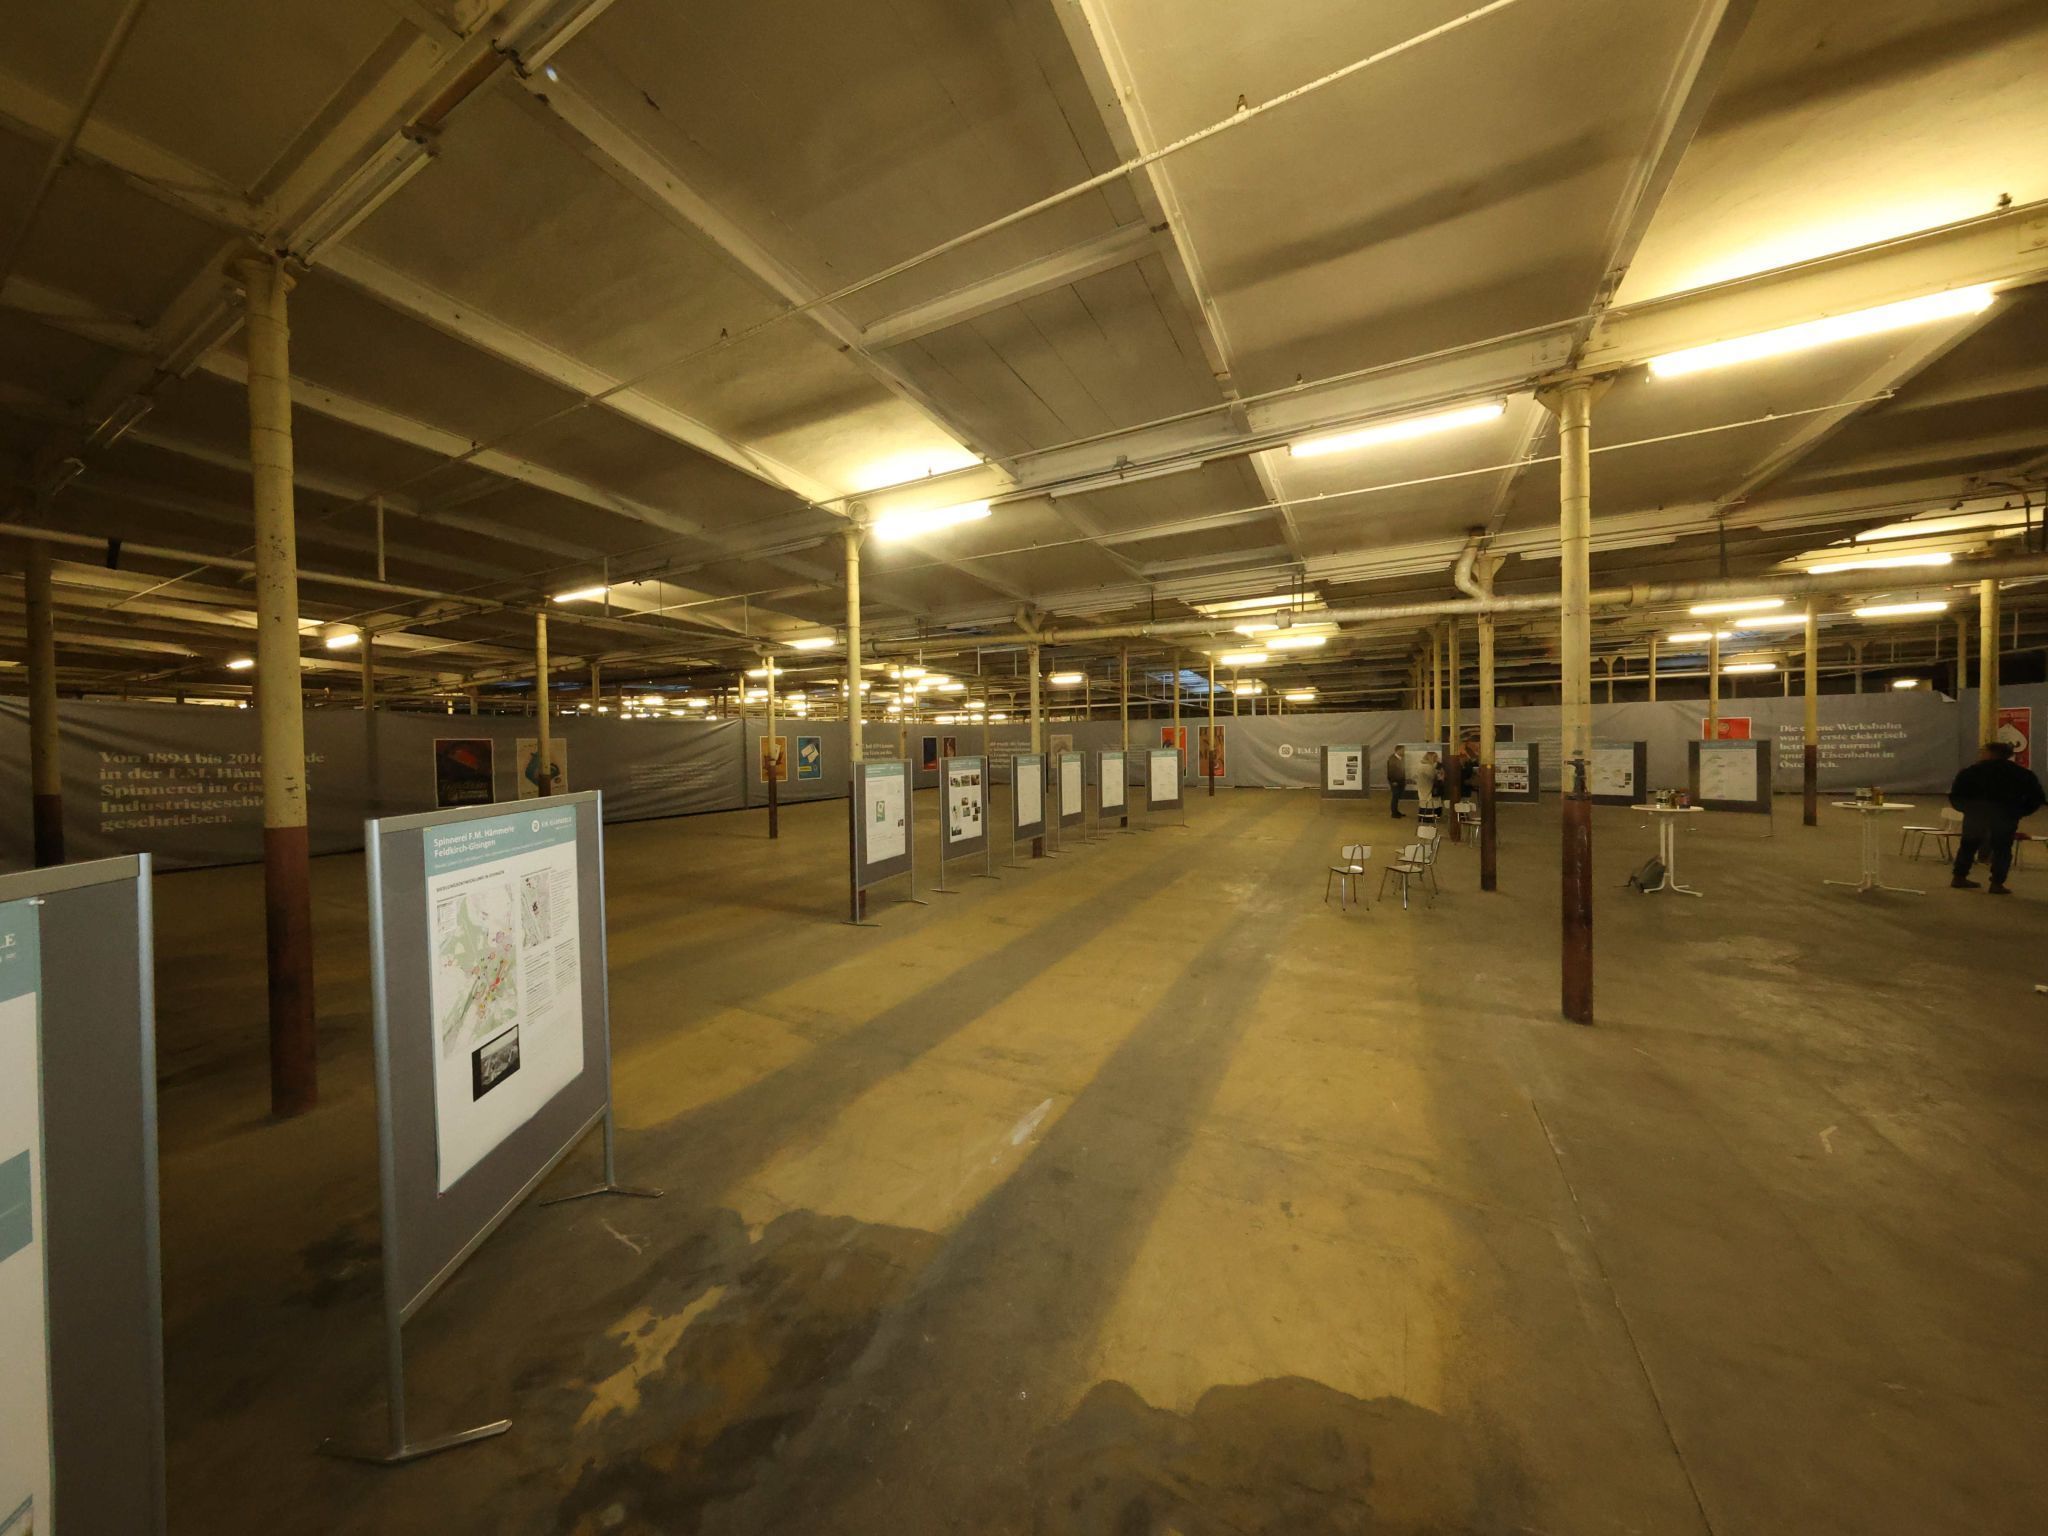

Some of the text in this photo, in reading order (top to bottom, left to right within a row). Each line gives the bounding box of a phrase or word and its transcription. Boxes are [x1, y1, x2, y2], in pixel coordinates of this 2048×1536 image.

[1837, 722, 1902, 731] Werksbahn
[99, 752, 141, 764] Von
[148, 752, 193, 764] 1894
[195, 752, 222, 764] bis
[99, 767, 121, 780] in
[128, 767, 162, 780] der
[101, 781, 203, 799] Spinnerei
[208, 780, 229, 793] in
[434, 834, 468, 848] Spinnerei
[434, 839, 497, 857] Feldkirch-Gisingen
